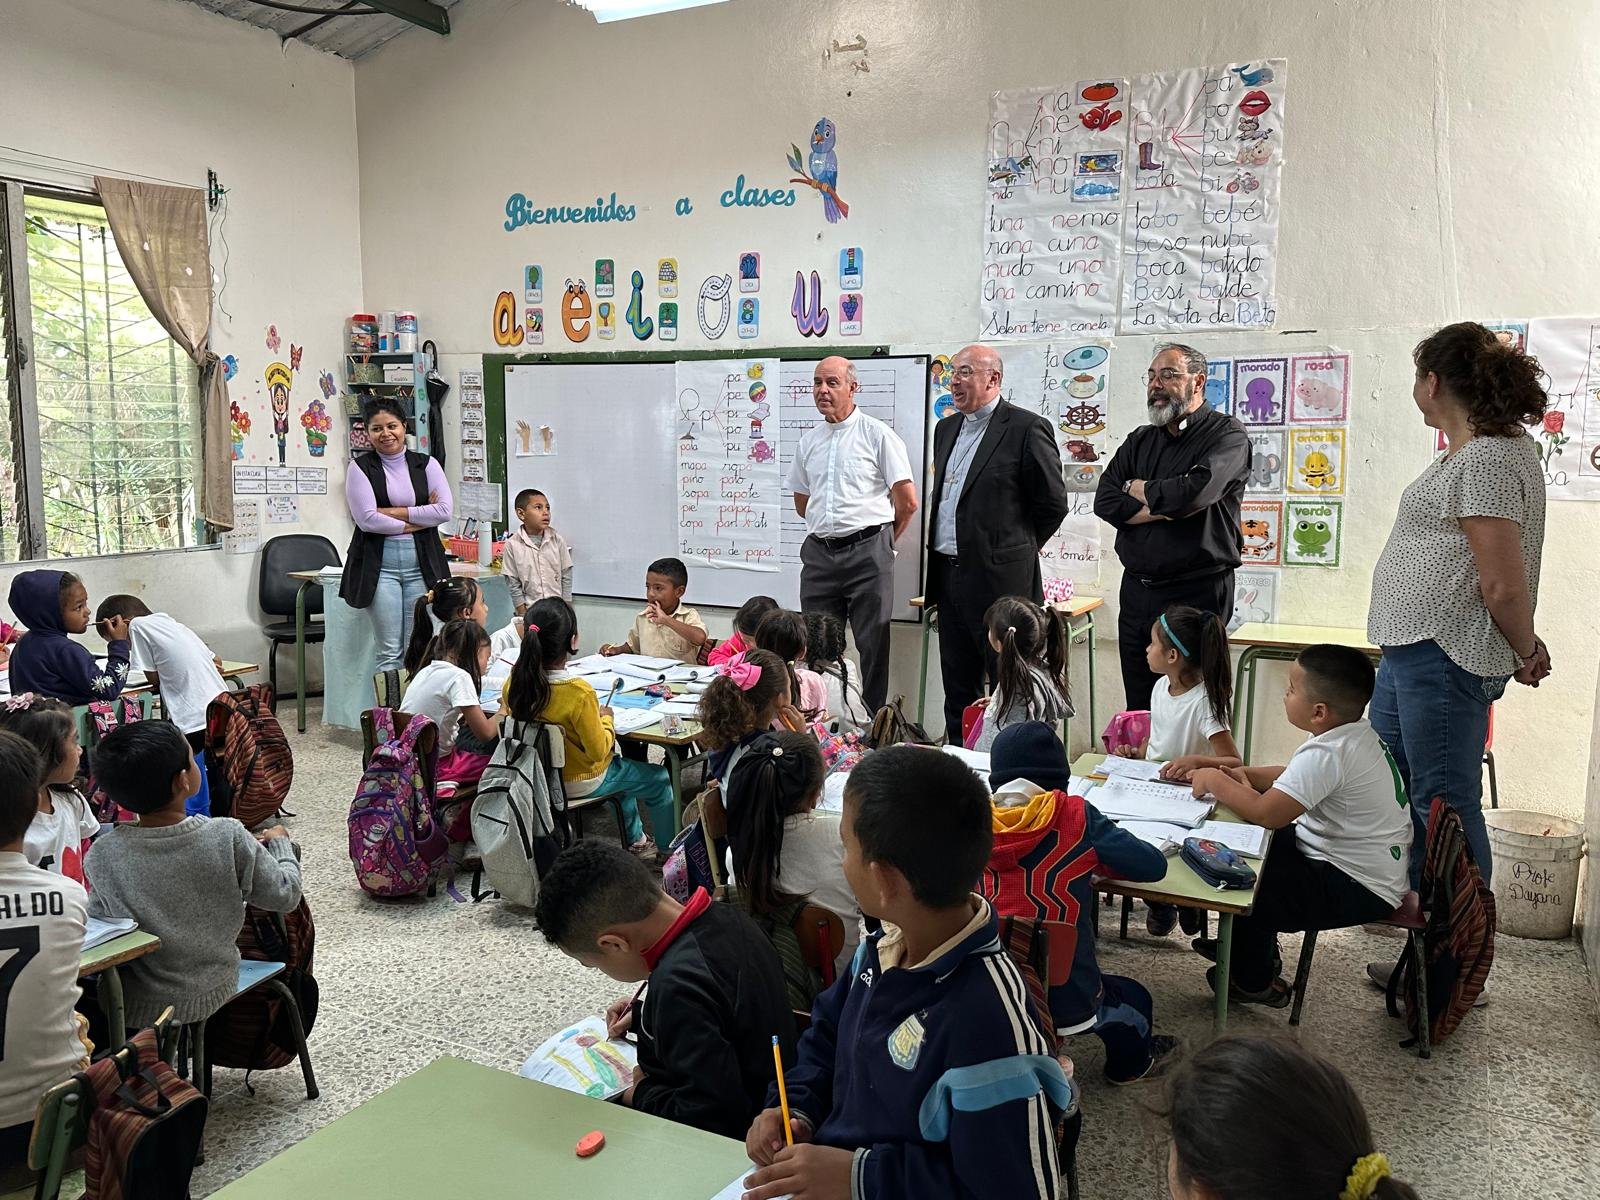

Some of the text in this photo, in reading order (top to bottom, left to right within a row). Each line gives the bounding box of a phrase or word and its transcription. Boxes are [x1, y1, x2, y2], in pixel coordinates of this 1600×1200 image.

[1204, 67, 1234, 94] ba
[1204, 95, 1234, 119] bo
[1036, 115, 1079, 134] ne
[1202, 119, 1232, 144] bu
[1036, 137, 1064, 155] ni
[1202, 144, 1238, 168] be
[1036, 157, 1073, 175] no
[1135, 161, 1178, 189] bota
[1035, 177, 1070, 195] nu
[1201, 167, 1223, 193] bi
[504, 174, 797, 232] Bienvenidos a clases
[992, 187, 1013, 199] nido
[990, 205, 1120, 232] luna nemo
[1135, 195, 1262, 229] lobo bebé
[986, 236, 1100, 255] rana cuna
[1135, 223, 1260, 252] beso nube
[985, 254, 1104, 278] nudo uno
[1136, 247, 1264, 277] boca batido
[984, 280, 1103, 301] Ana camino
[1132, 272, 1260, 300] Besi balde
[561, 284, 593, 343] e
[626, 270, 654, 340] i
[697, 273, 733, 340] o
[791, 270, 829, 338] u
[1130, 302, 1156, 325] La
[1168, 299, 1201, 325] bota
[1209, 298, 1234, 324] de
[493, 291, 525, 347] a
[981, 311, 1027, 336] Selena
[1030, 309, 1065, 333] tiene
[1044, 345, 1060, 367] ta
[1304, 361, 1334, 371] rosa
[1240, 362, 1281, 374] morado
[725, 374, 741, 389] pa
[1041, 369, 1061, 391] te
[724, 391, 742, 407] pe
[1039, 394, 1052, 415] ti
[725, 427, 742, 440] po
[1297, 432, 1340, 443] amarillo
[681, 440, 698, 457] pala
[724, 443, 740, 458] pu
[681, 462, 752, 478] mapa ropa
[681, 470, 747, 491] pino pato
[682, 483, 760, 506] sopa capote
[681, 504, 697, 521] pie
[1295, 506, 1332, 516] verde
[680, 521, 703, 535] copa
[715, 519, 738, 536] pan
[680, 539, 693, 554] La
[697, 547, 721, 563] copa
[728, 541, 740, 556] de
[1059, 542, 1097, 561] tomate
[1512, 861, 1556, 888] Profe
[1508, 883, 1562, 910] Dayana
